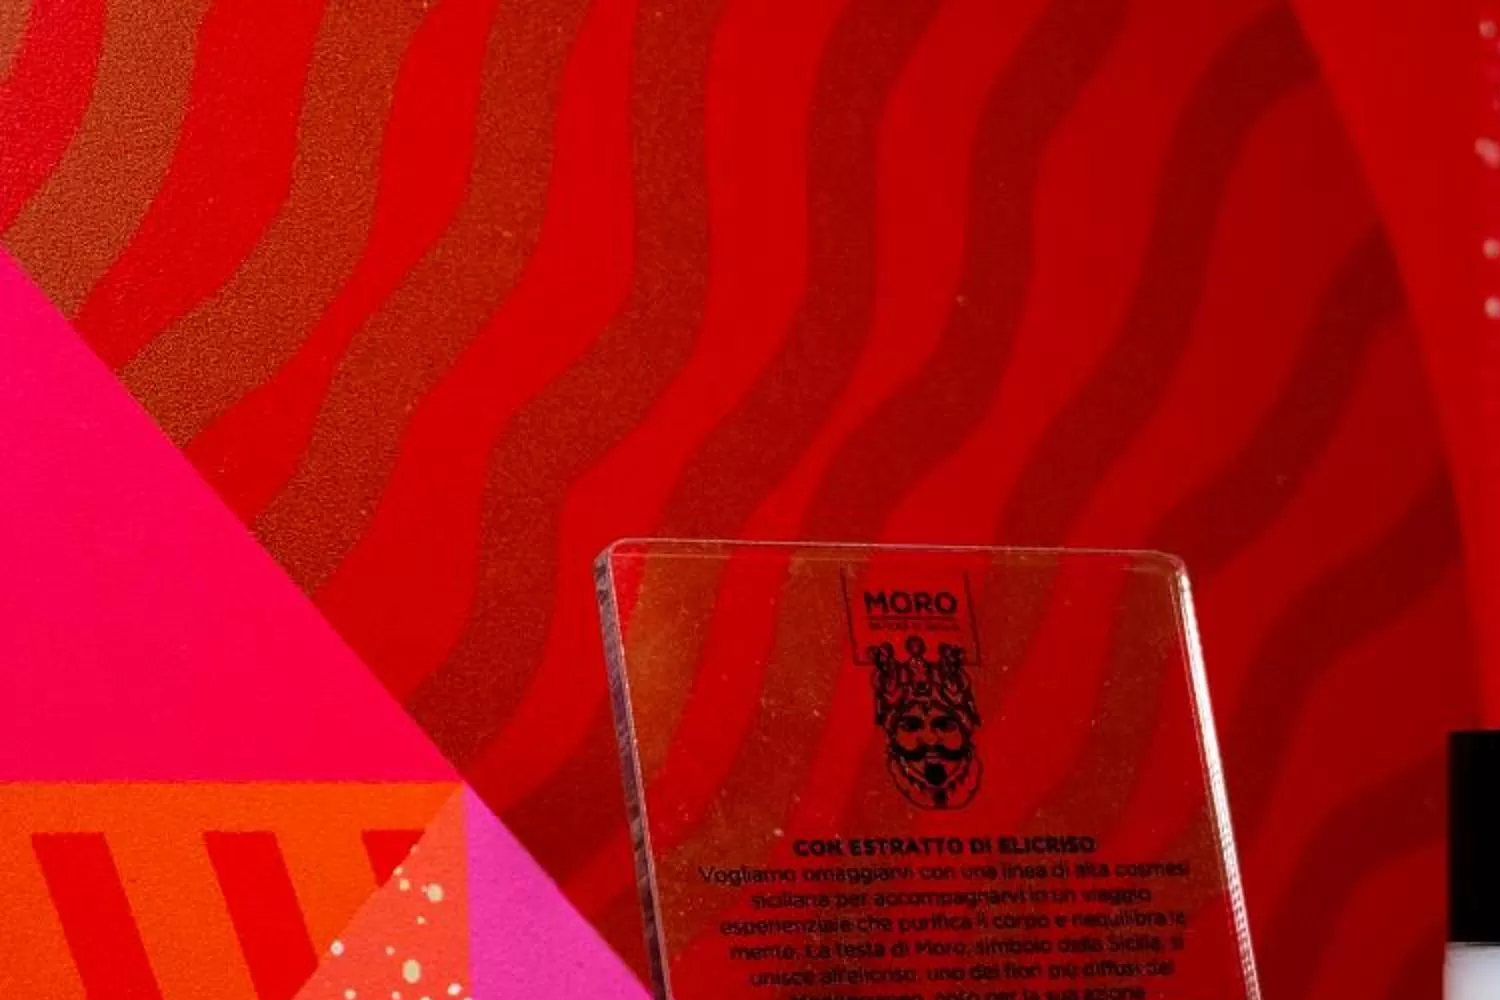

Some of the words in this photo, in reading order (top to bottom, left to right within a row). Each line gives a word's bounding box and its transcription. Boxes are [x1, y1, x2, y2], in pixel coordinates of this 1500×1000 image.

[864, 592, 957, 615] MORO
[793, 839, 842, 857] CON
[851, 836, 963, 856] ESTRATTO
[971, 836, 992, 854] DI
[997, 835, 1096, 853] ELICRISO
[699, 865, 796, 886] Vogliamo
